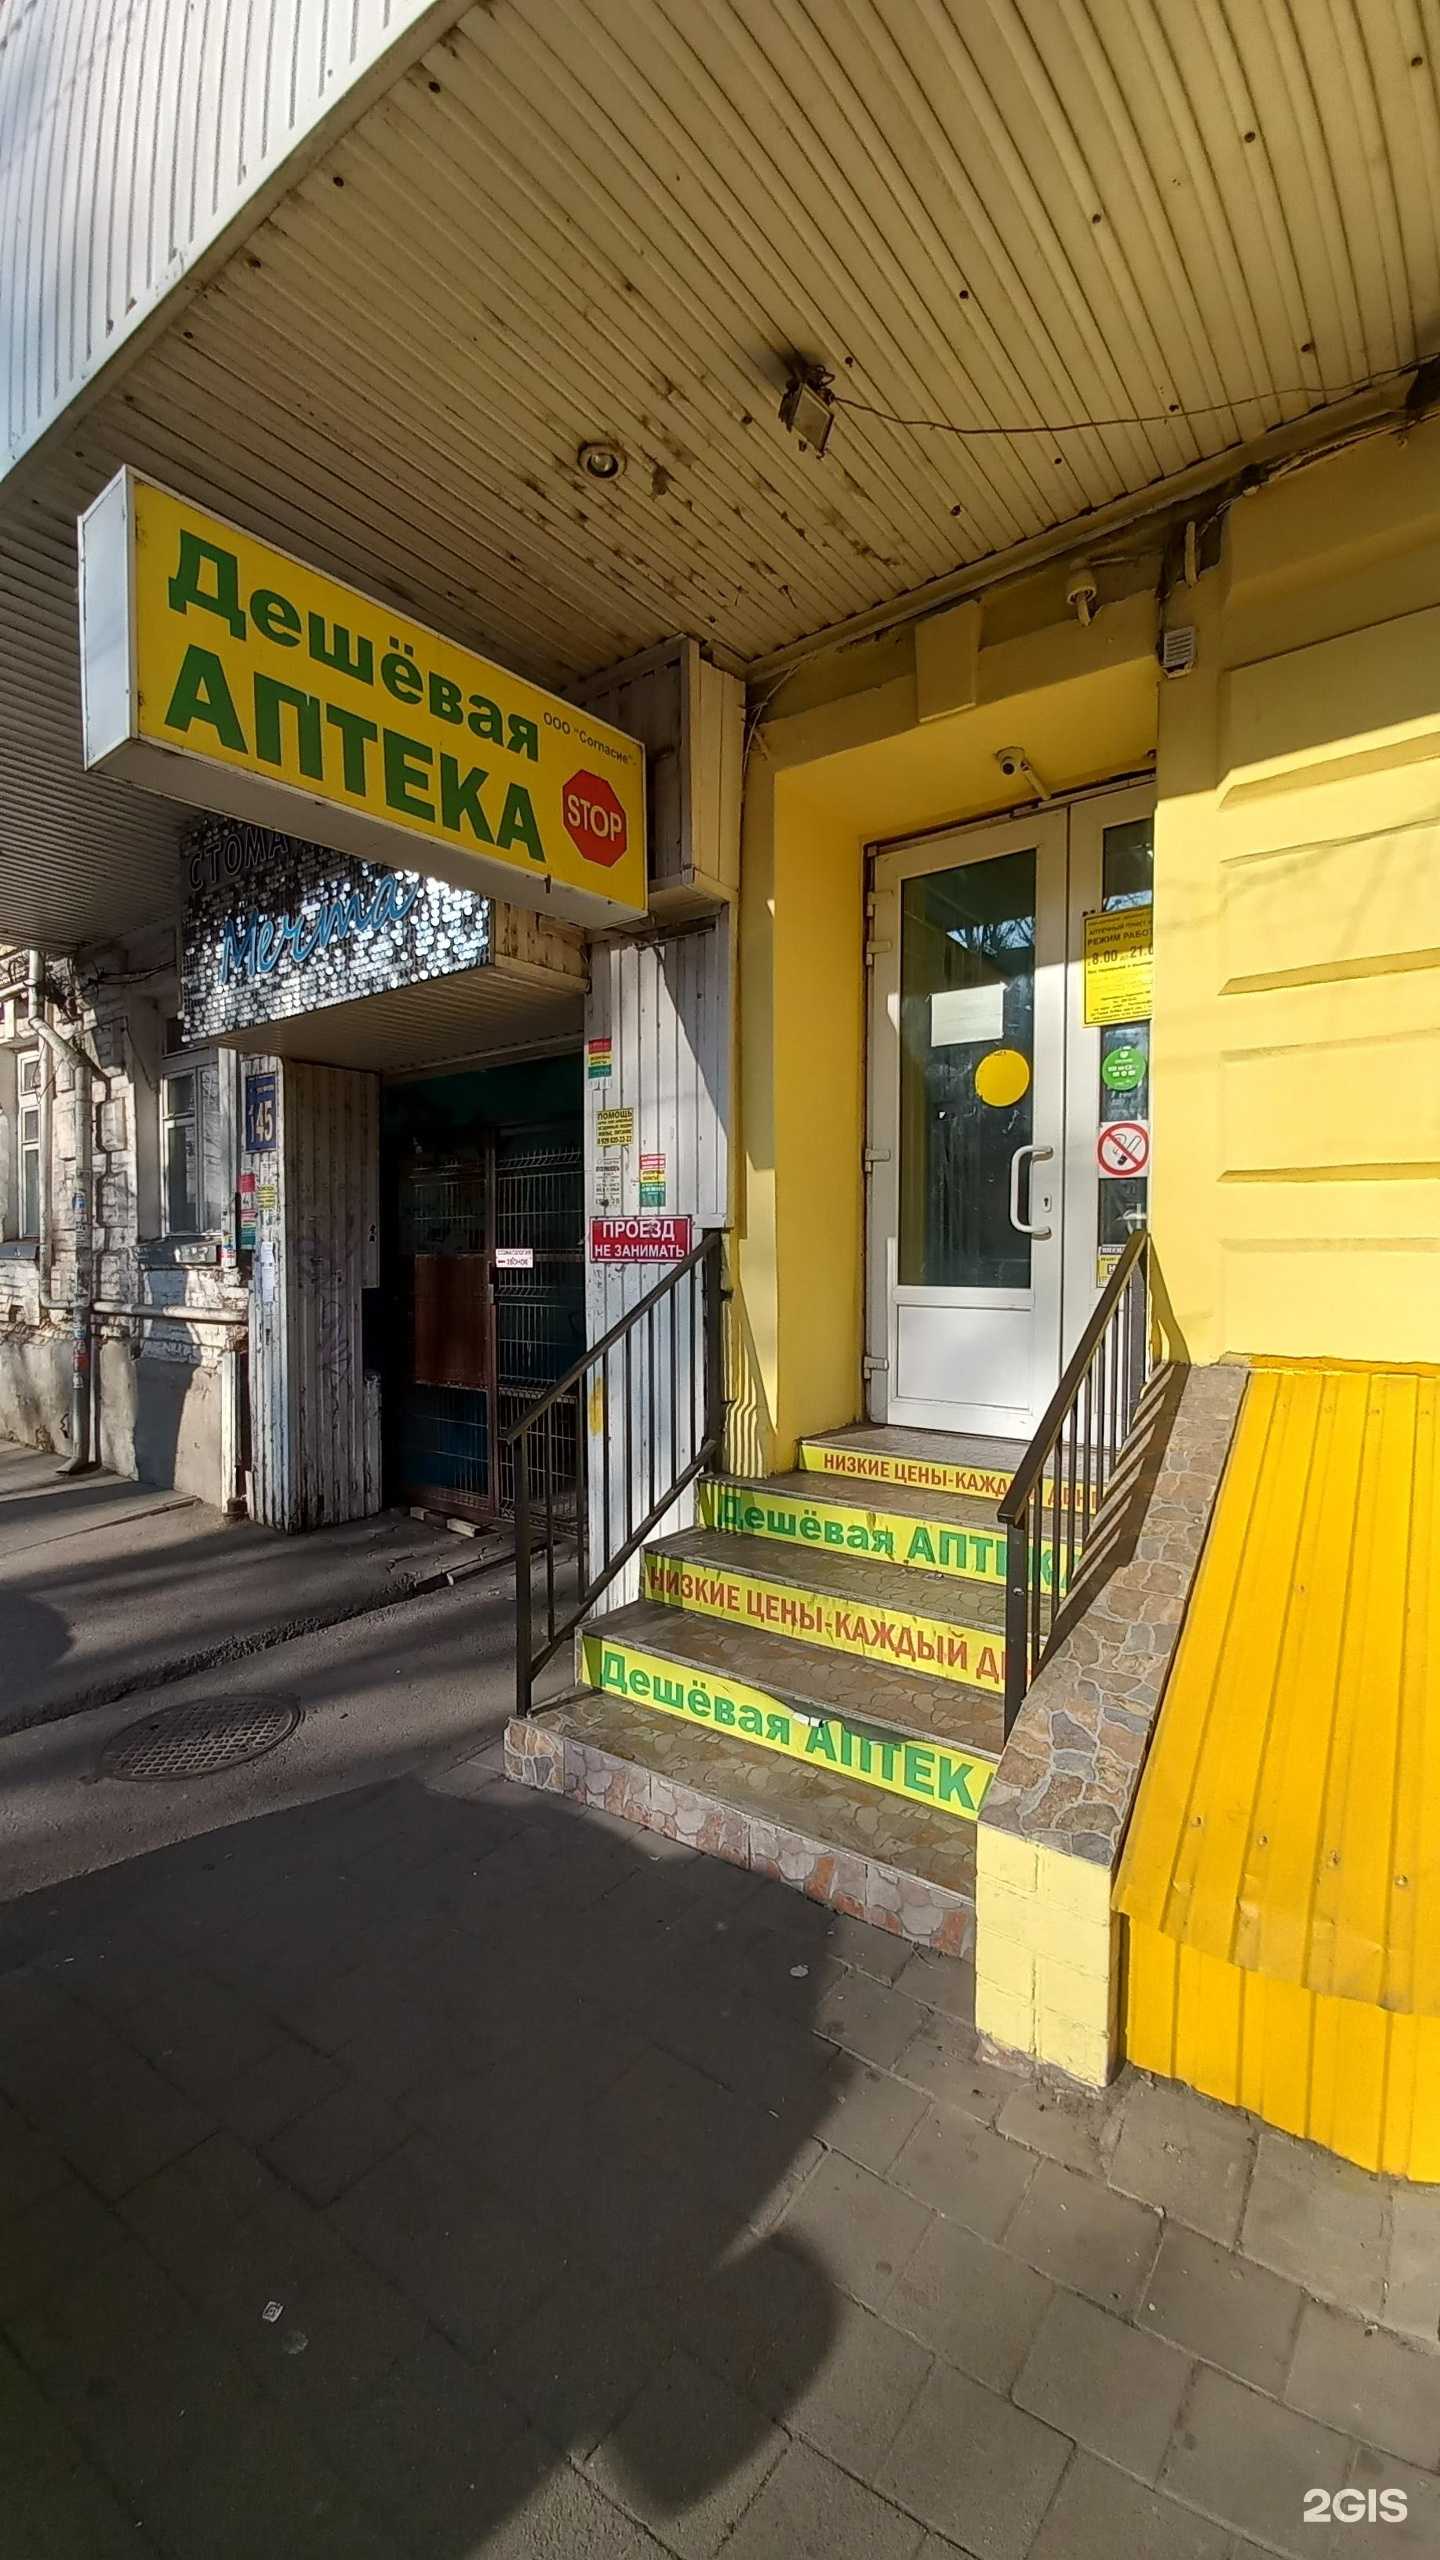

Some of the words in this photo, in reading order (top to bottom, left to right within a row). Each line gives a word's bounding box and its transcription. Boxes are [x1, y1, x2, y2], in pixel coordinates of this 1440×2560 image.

[168, 528, 539, 762] Дешёвая
[543, 712, 571, 735] ООО
[164, 643, 546, 863] АПТЕКА
[567, 794, 622, 842] STOP
[190, 826, 290, 891] СТОМА
[1123, 927, 1153, 939] РАБОТ
[1130, 943, 1153, 958] 21.0
[594, 1244, 611, 1257] НЕ
[614, 1244, 685, 1257] ЗАНИМАТЬ
[603, 1220, 675, 1242] ПРОЕЗД
[824, 1453, 890, 1478] НИЗКИЕ
[894, 1464, 1013, 1497] ЦЕНЫ-КАЖД
[717, 1493, 896, 1553] Дешёвая
[650, 1565, 740, 1612] НИЗКИЕ
[602, 1651, 790, 1746] Дешёвая
[804, 1719, 994, 1812] АПТЕК
